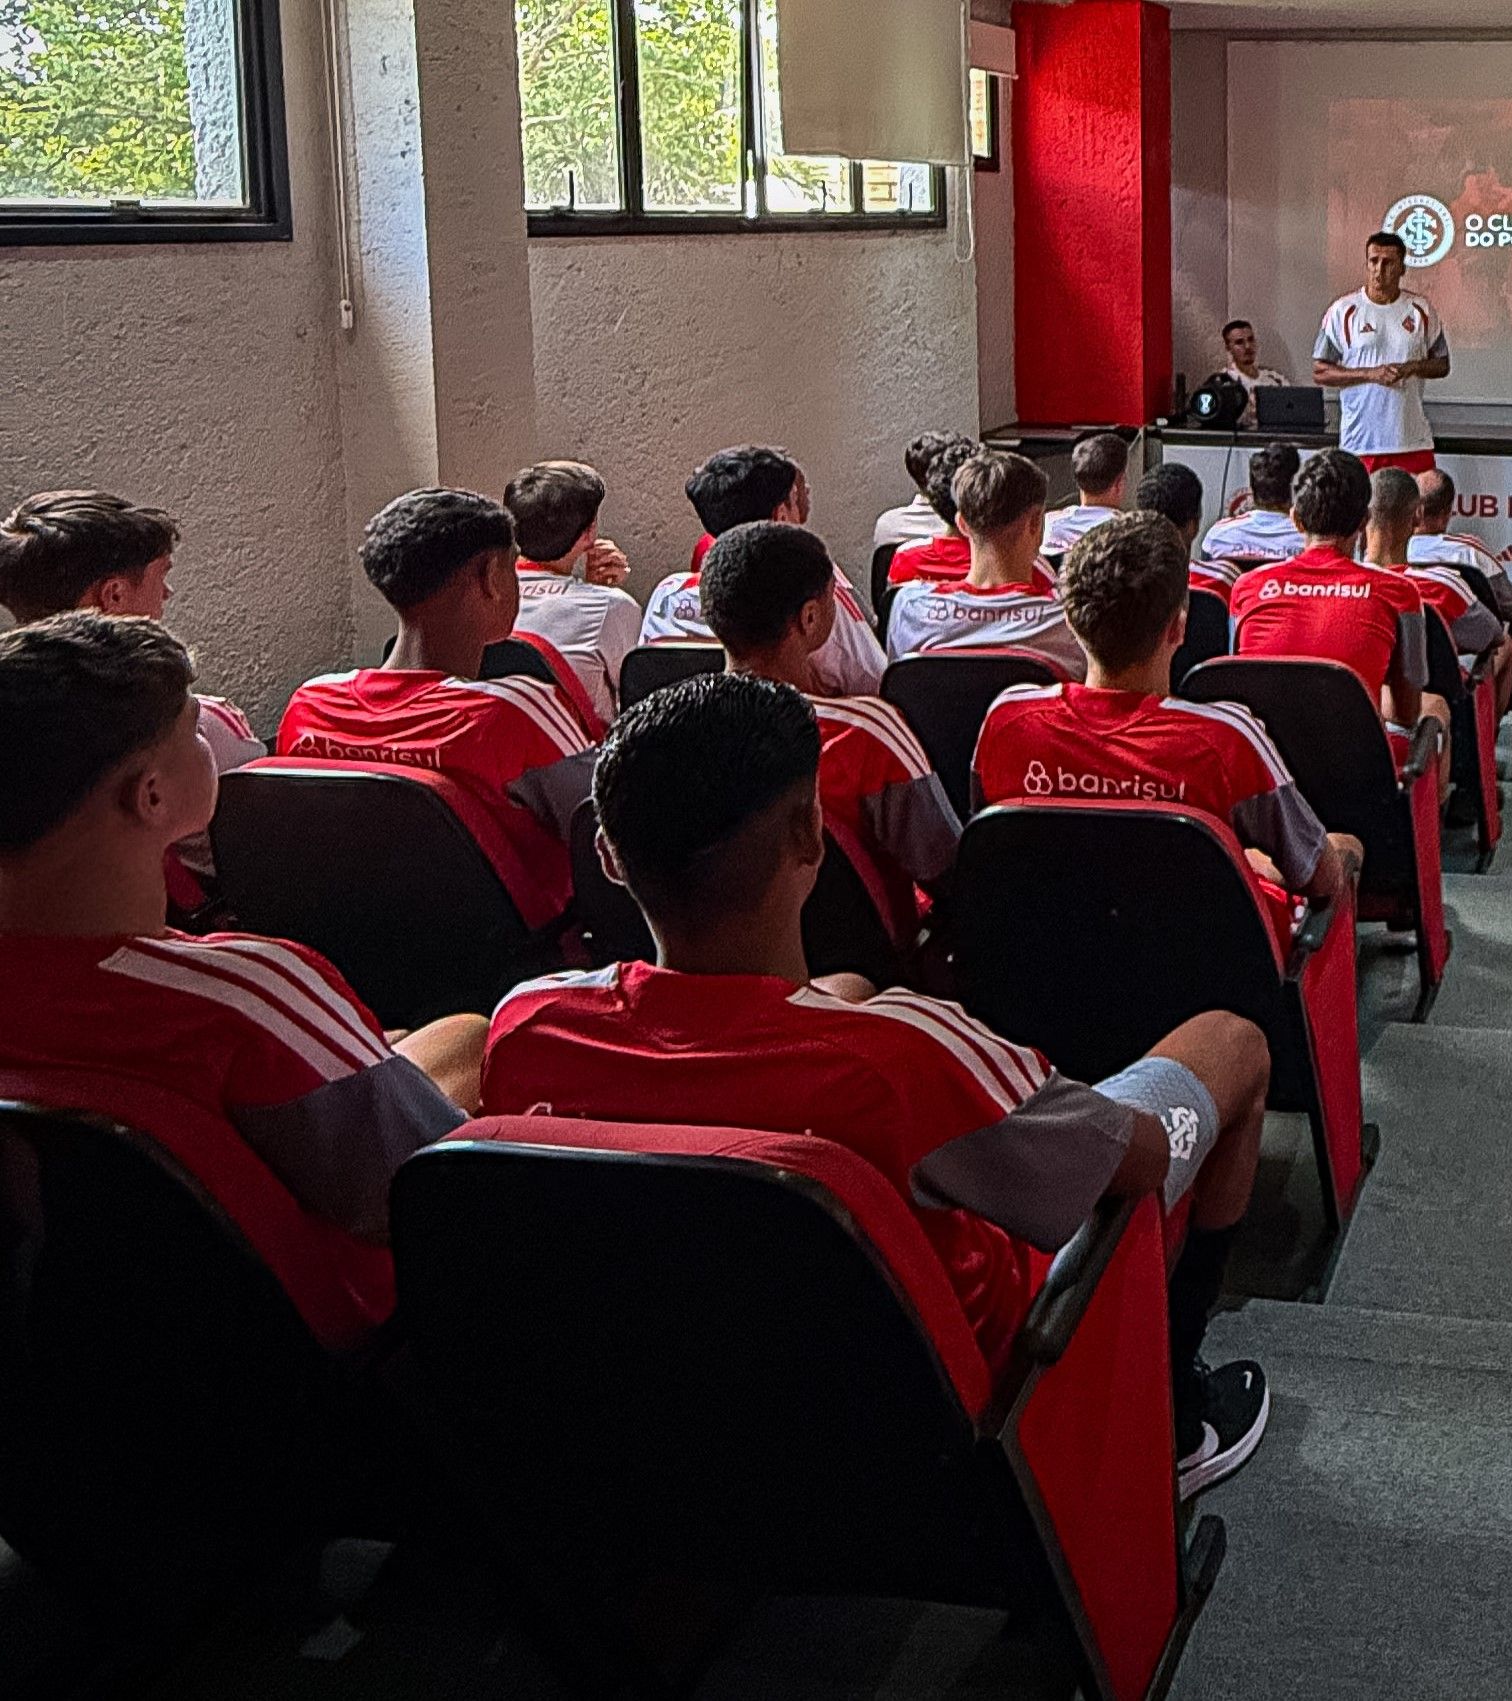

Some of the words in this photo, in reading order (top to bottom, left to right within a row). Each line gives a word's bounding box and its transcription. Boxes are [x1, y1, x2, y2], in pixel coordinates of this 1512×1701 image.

[1465, 214, 1483, 232] O
[1465, 231, 1494, 247] DO
[1452, 494, 1499, 518] UB
[523, 581, 570, 596] risul
[1283, 580, 1371, 599] banrisul
[953, 601, 1045, 624] banrisul
[1057, 766, 1186, 800] banrisul
